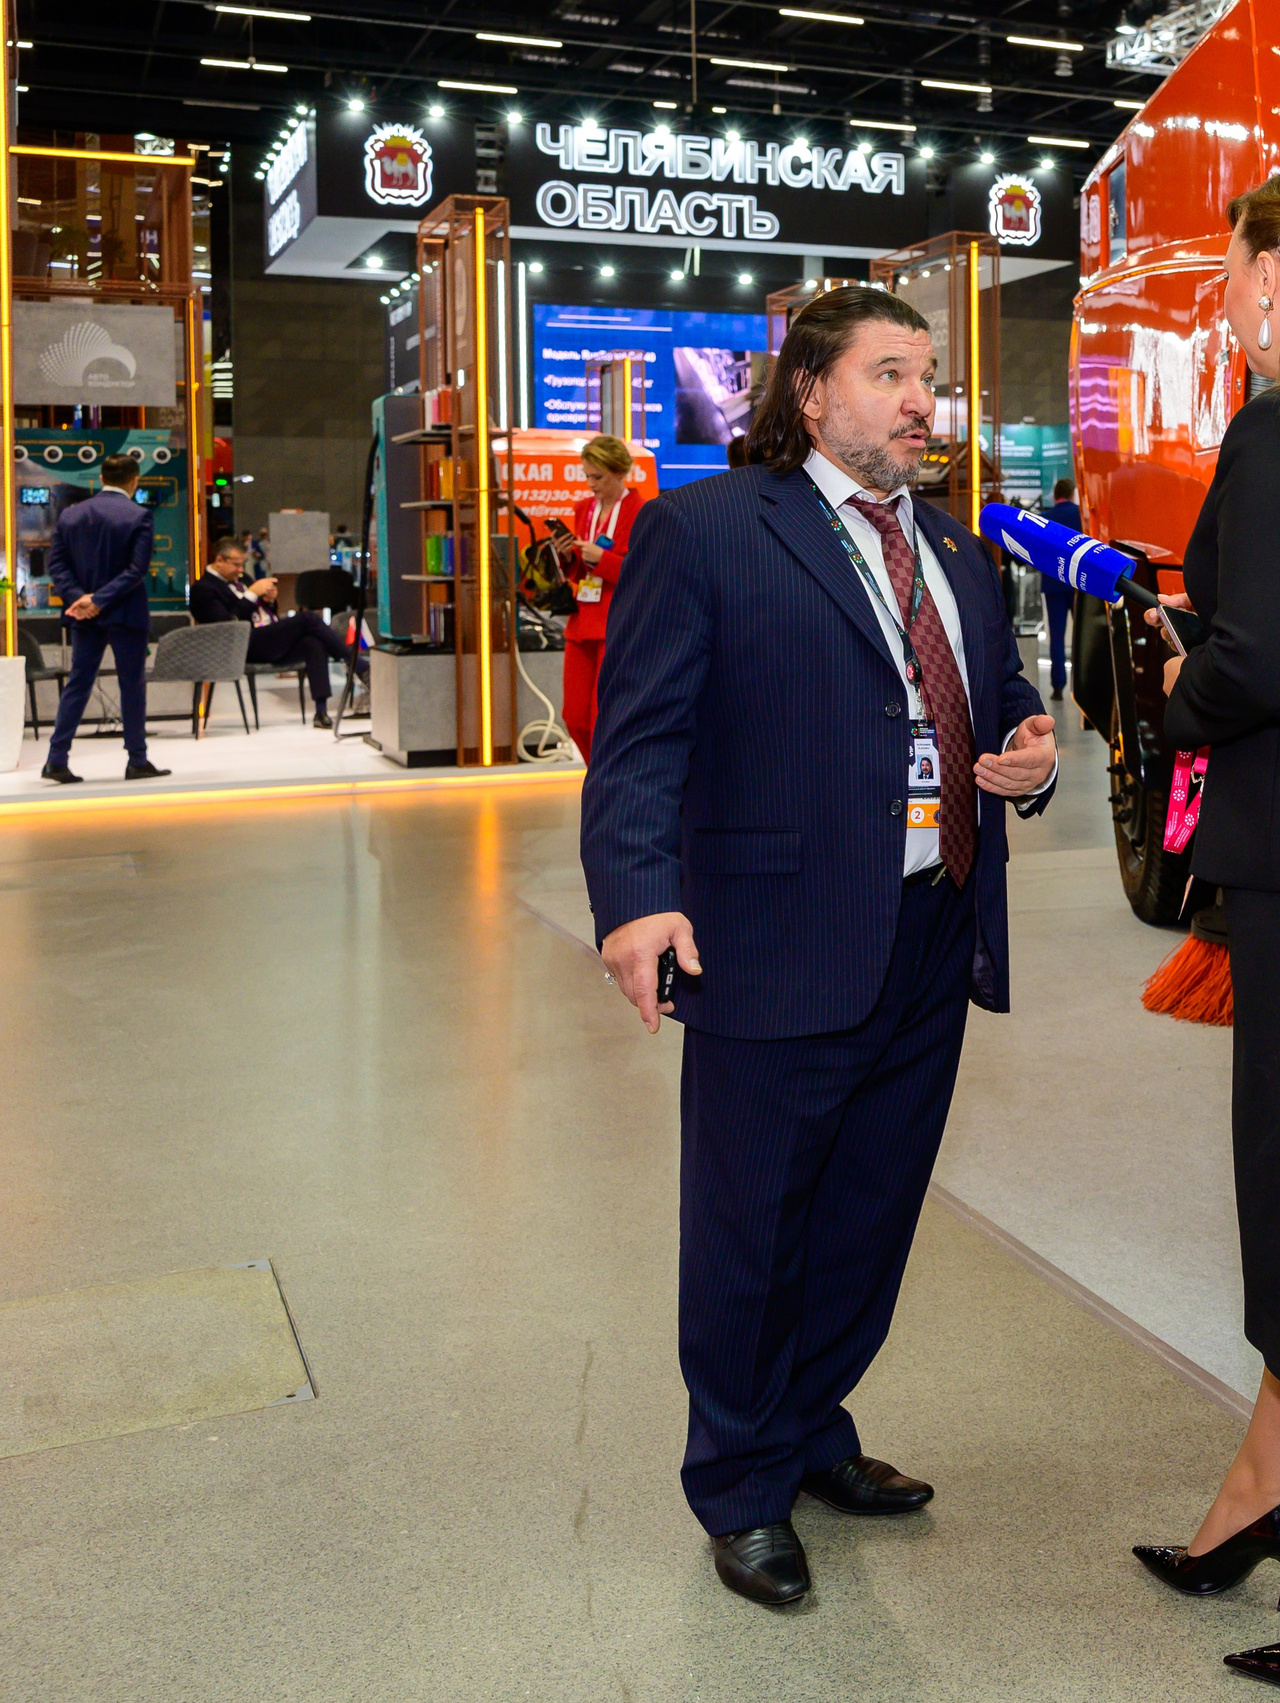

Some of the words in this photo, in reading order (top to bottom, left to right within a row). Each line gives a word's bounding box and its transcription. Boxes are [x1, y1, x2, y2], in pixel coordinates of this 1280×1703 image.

[536, 122, 905, 195] ЧЕЛЯБИНСКАЯ
[536, 180, 780, 240] ОБЛАСТЬ
[914, 810, 921, 820] 2
